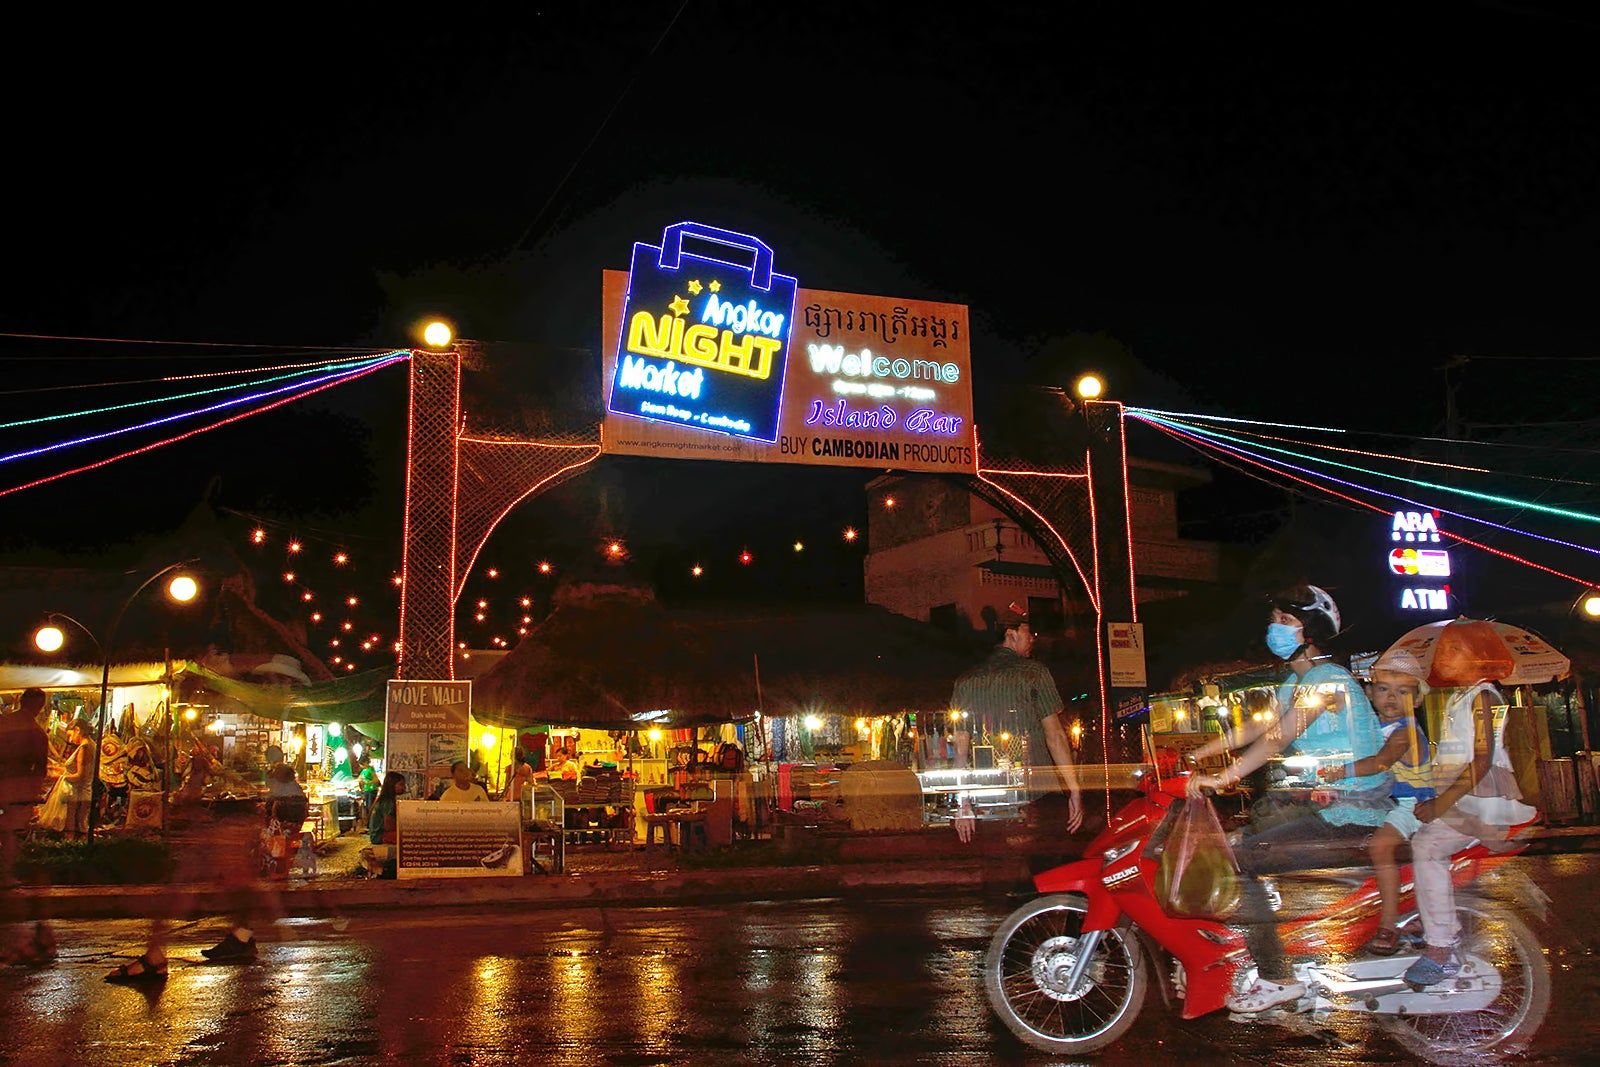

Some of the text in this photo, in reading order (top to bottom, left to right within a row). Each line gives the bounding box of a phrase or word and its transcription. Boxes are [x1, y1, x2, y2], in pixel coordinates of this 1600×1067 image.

[701, 293, 785, 338] Angkor
[619, 354, 704, 400] Market
[807, 343, 960, 384] Welcome
[806, 399, 963, 434] Island Bar
[780, 436, 972, 465] BUY CAMBODIAN PRODUCTS
[1401, 588, 1448, 610] ATM
[432, 686, 466, 706] MALL
[1102, 865, 1139, 884] SUZUKI
